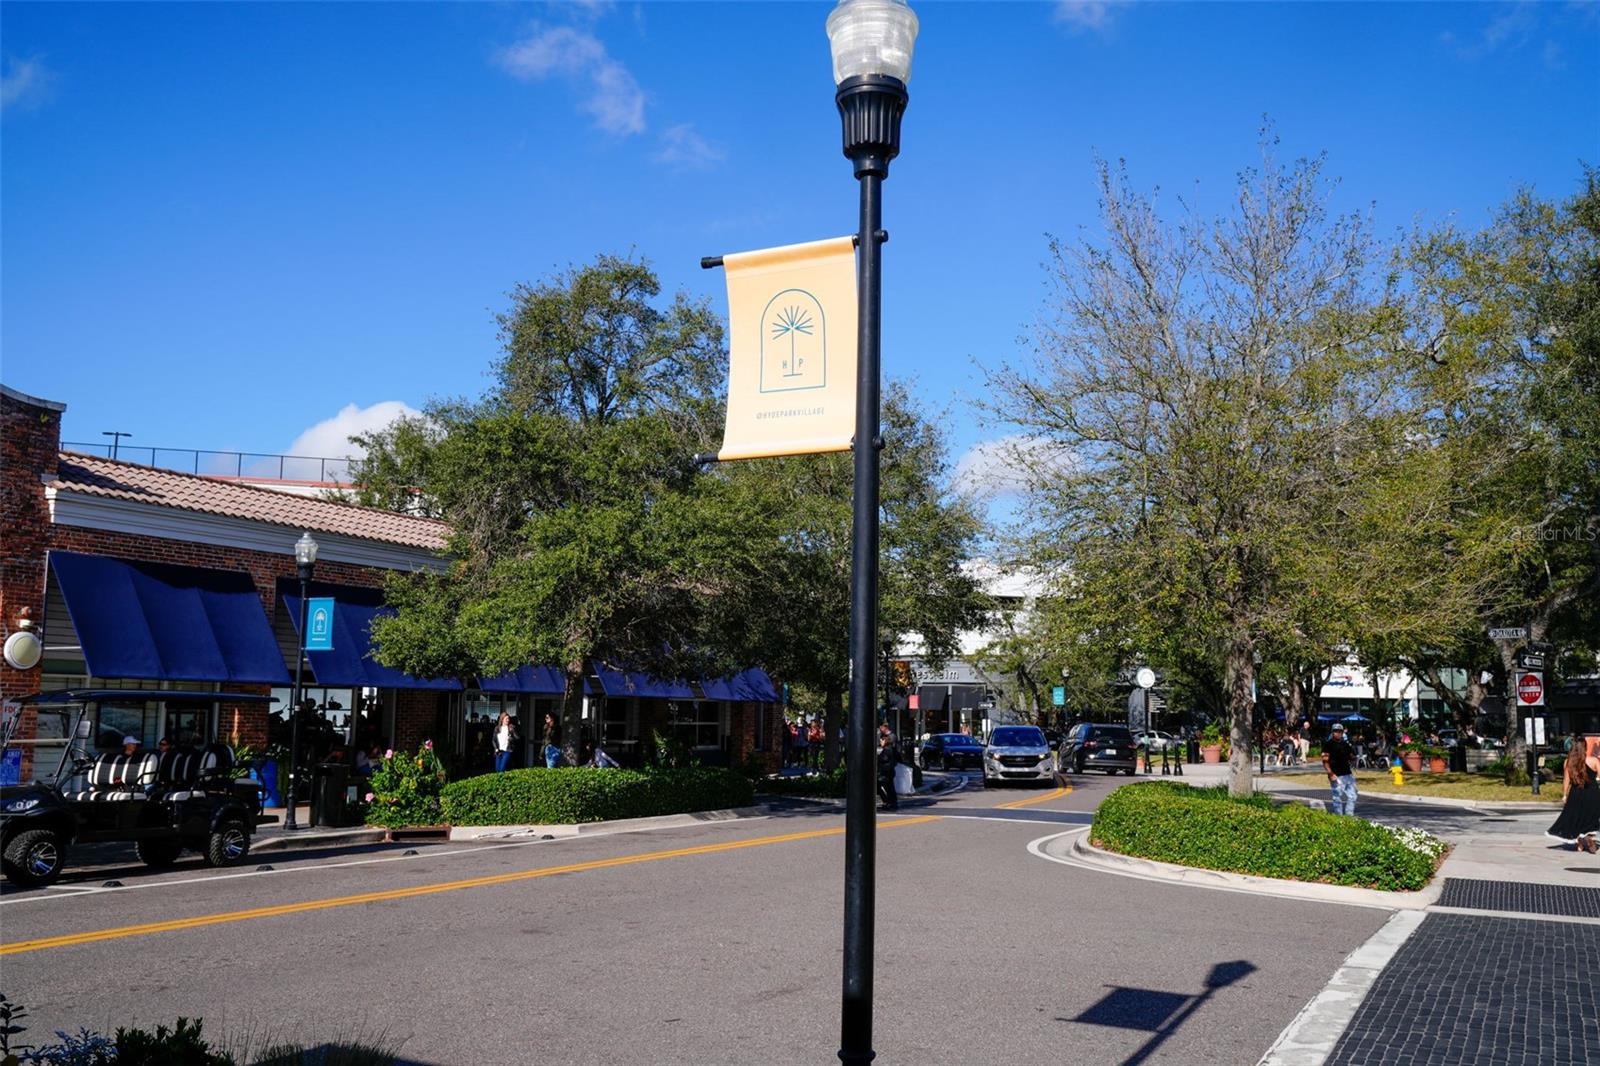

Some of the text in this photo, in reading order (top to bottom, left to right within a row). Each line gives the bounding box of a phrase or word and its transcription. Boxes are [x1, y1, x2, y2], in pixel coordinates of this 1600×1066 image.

[782, 358, 804, 369] H P
[756, 407, 825, 419] @HYDEPARKVILLAGE
